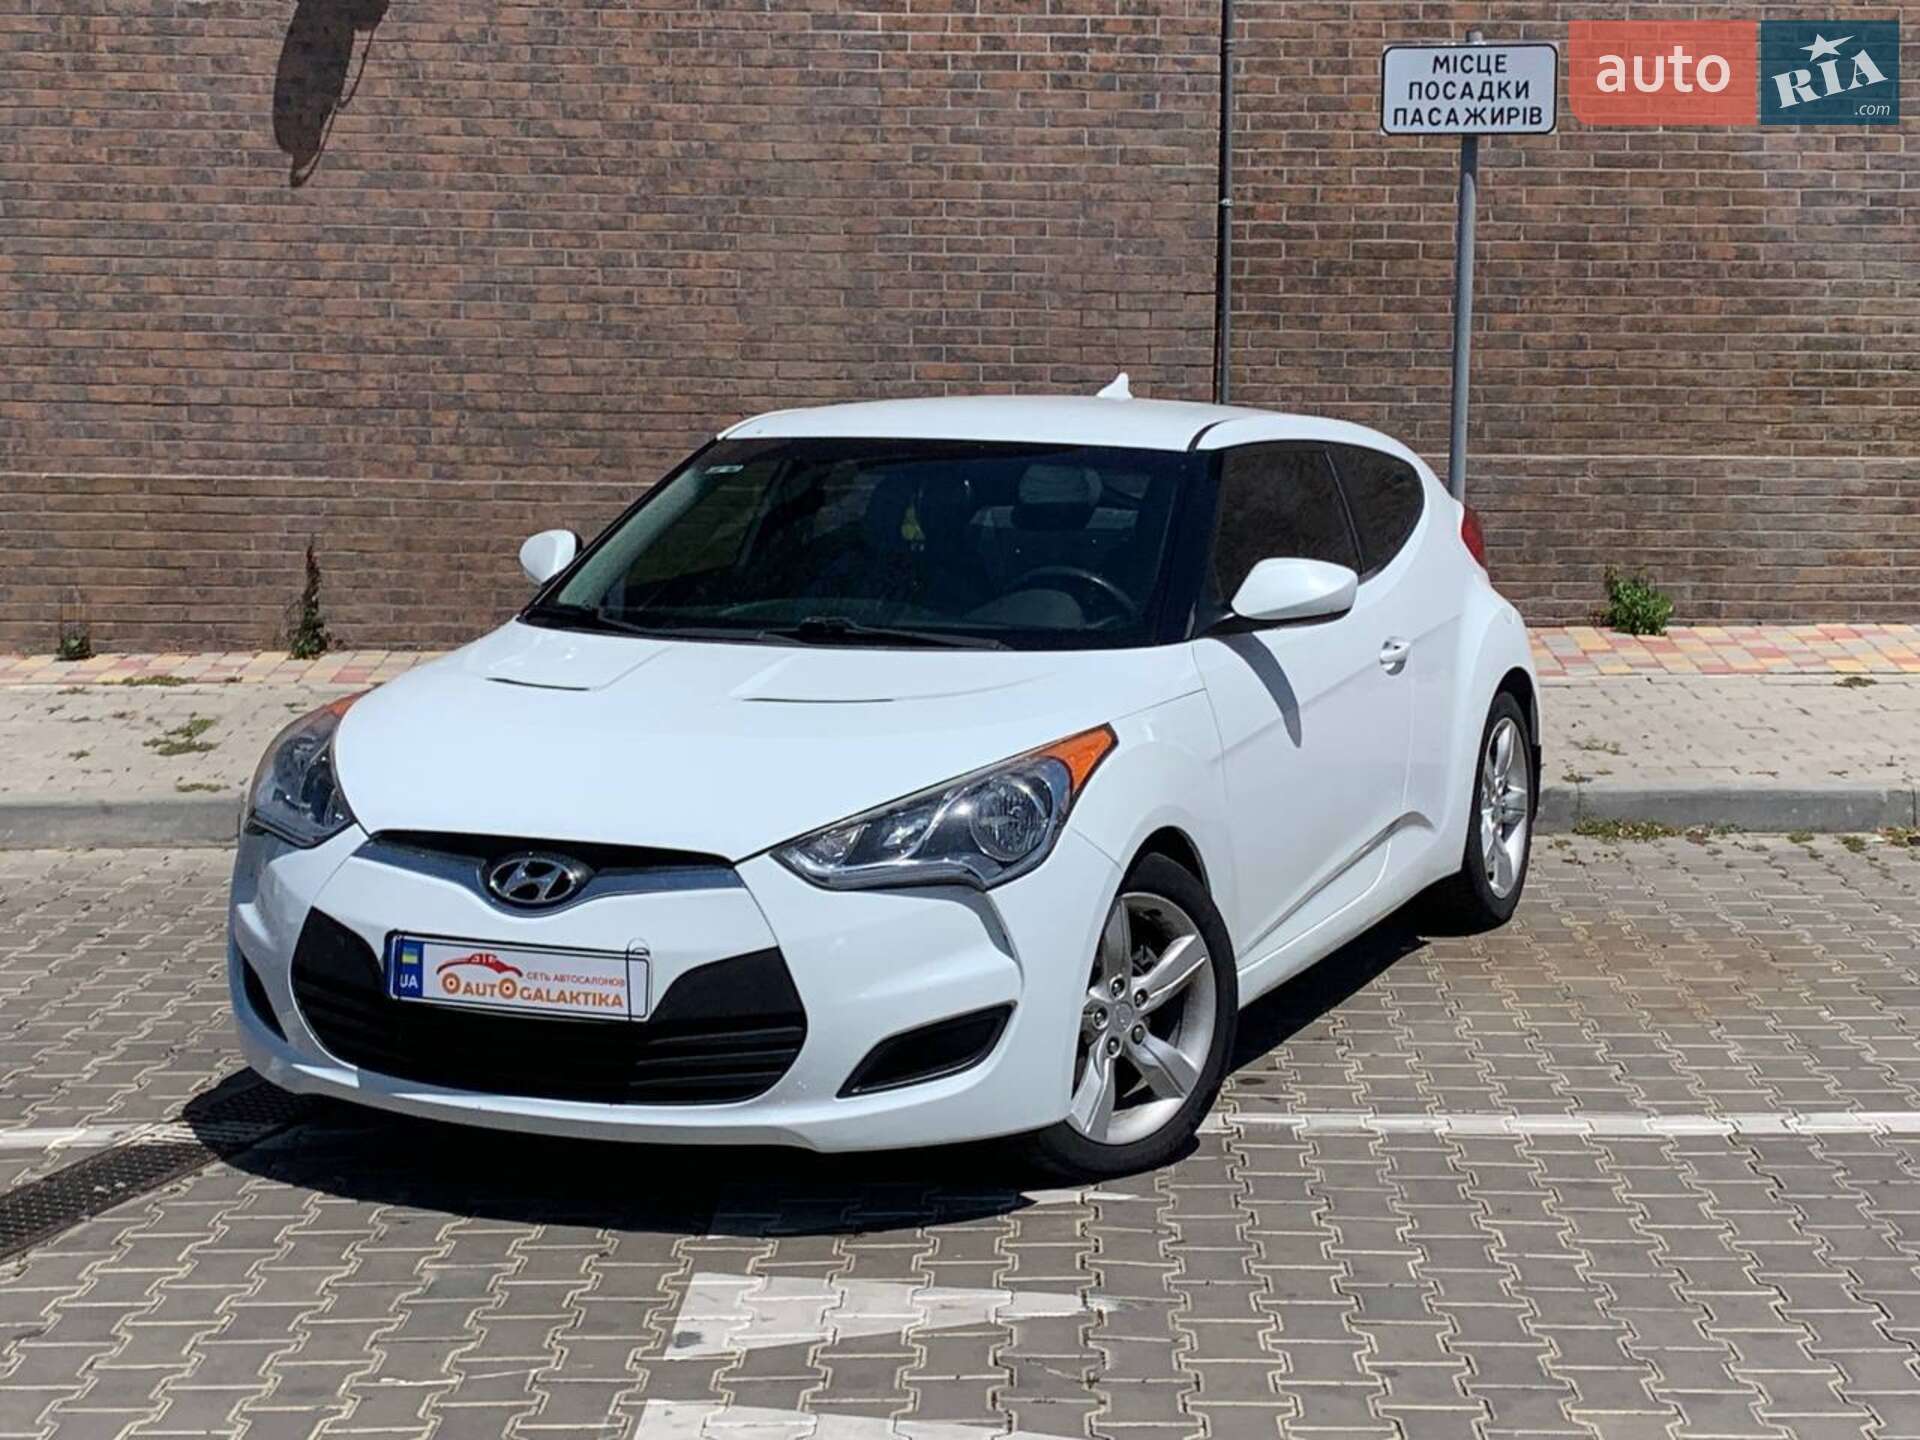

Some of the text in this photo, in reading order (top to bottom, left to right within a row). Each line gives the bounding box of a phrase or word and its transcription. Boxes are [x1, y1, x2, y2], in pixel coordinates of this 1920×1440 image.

[1432, 54, 1507, 76] МІСЦЕ
[1408, 80, 1530, 102] ПОСАДКИ
[1393, 106, 1543, 126] ПАСАЖИРІВ
[400, 973, 419, 989] UA
[526, 971, 625, 988] СЕТЬ АВТОСАЛОНОВ
